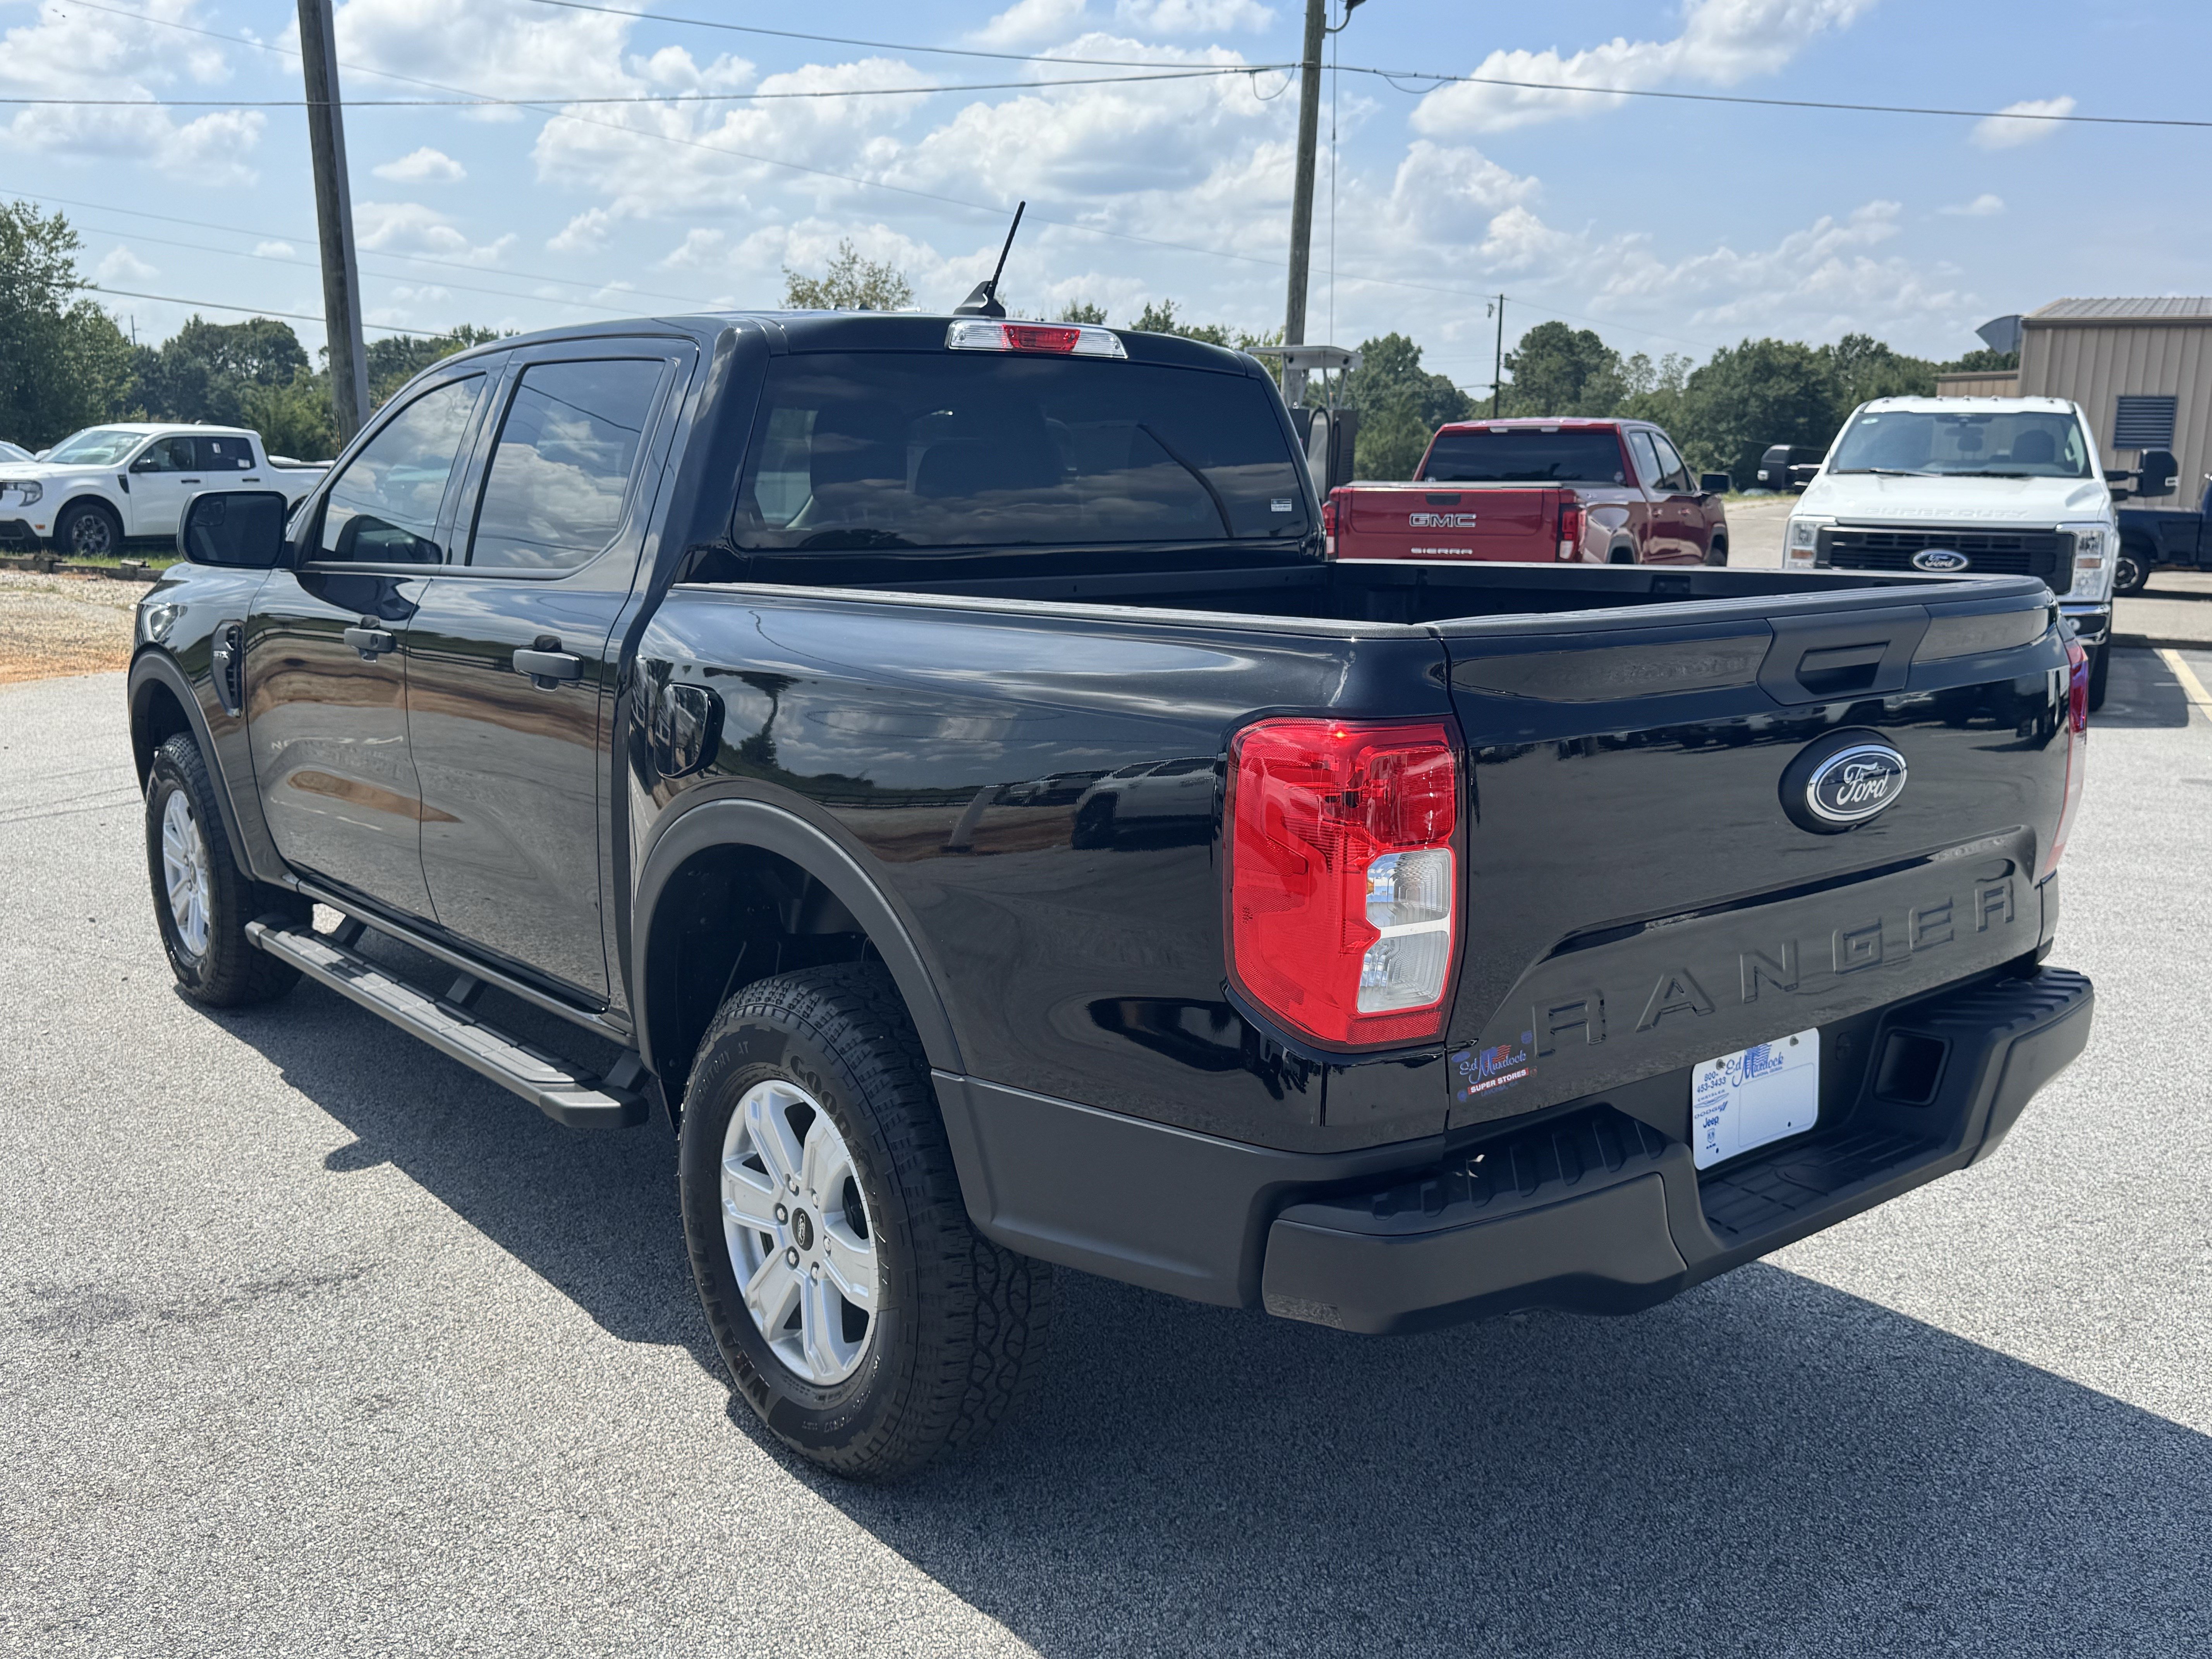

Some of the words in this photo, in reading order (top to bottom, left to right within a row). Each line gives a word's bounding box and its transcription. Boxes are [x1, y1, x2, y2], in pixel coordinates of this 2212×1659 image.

[1409, 513, 1476, 527] GMC
[1925, 553, 1956, 568] Ford
[1836, 760, 1890, 806] Ford
[1533, 877, 2014, 1059] RANGER
[735, 1040, 750, 1057] AT
[1459, 1058, 1479, 1075] Ed
[1468, 1049, 1527, 1084] Murdock
[1726, 1056, 1741, 1075] Ed
[1471, 1079, 1496, 1093] SUPER
[1498, 1069, 1527, 1084] STORES
[1697, 1076, 1726, 1093] 453-3433
[1704, 1071, 1718, 1082] 800-
[1703, 1116, 1719, 1128] Jeep
